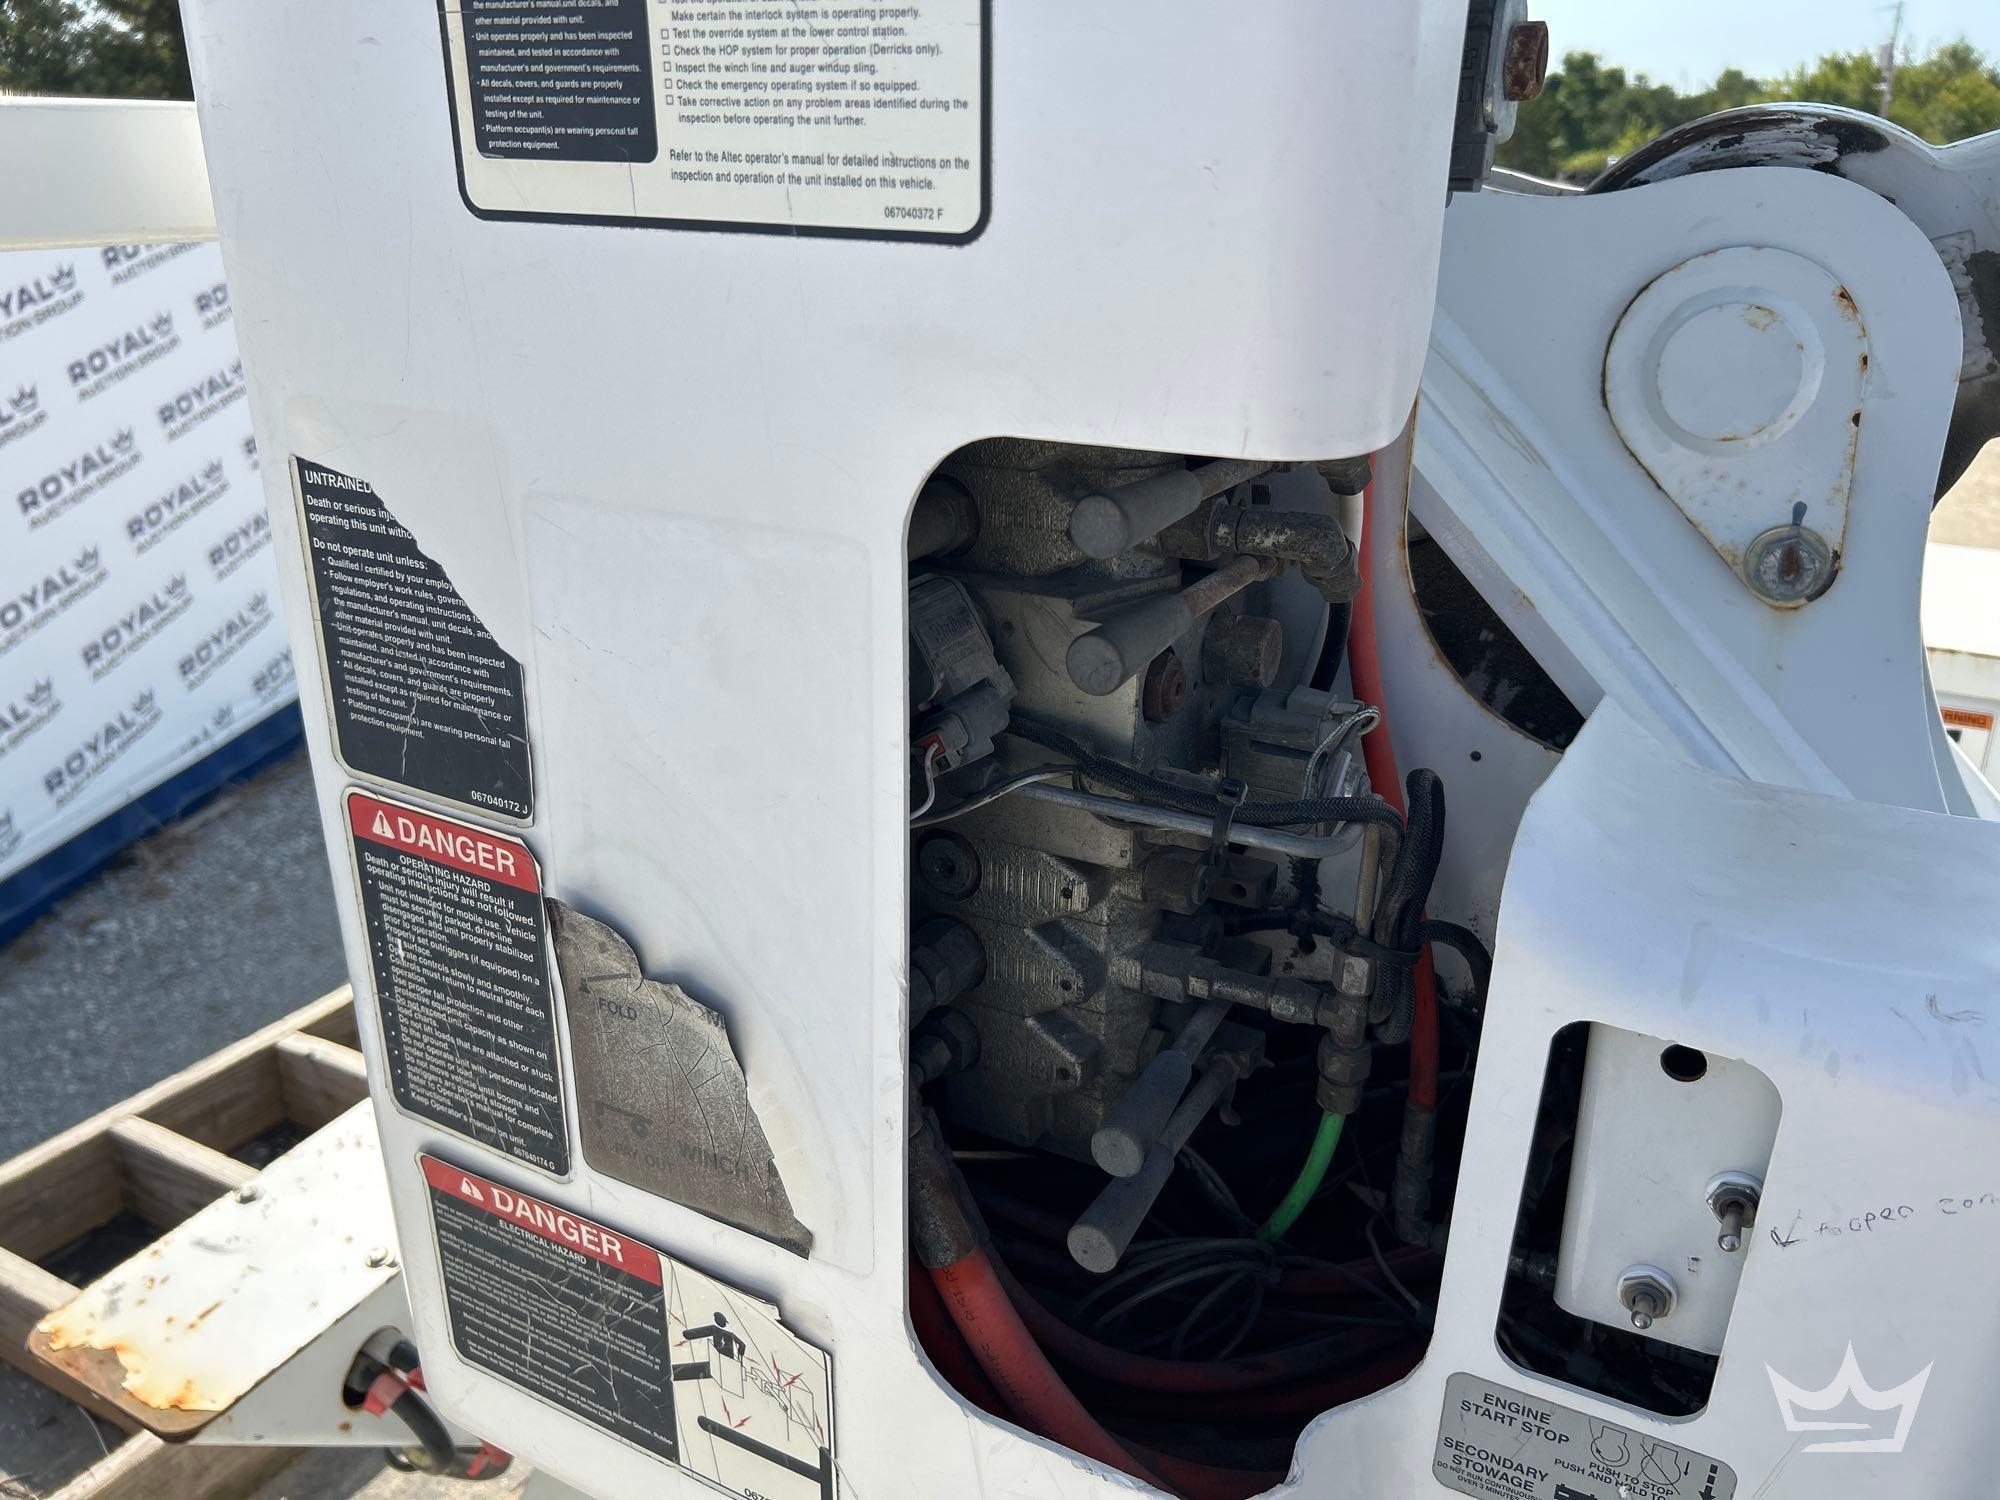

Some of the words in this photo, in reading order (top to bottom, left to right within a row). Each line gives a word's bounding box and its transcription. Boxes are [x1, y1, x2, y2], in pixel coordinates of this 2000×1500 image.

[673, 29, 690, 39] Test
[692, 29, 706, 39] the
[708, 28, 745, 39] override
[746, 28, 779, 41] system
[781, 28, 790, 38] at
[792, 28, 807, 38] the
[809, 27, 834, 37] lower
[837, 27, 869, 37] control
[872, 27, 907, 37] station.
[674, 46, 700, 56] Check
[702, 46, 716, 56] the
[719, 45, 739, 56] HOP
[741, 45, 773, 58] system
[775, 45, 788, 55] for
[790, 47, 820, 58] proper
[822, 45, 867, 57] operation
[869, 45, 913, 57] (Derricks
[915, 44, 943, 57] only).
[675, 62, 706, 75] Inspect
[708, 63, 722, 73] the
[724, 63, 749, 73] winch
[751, 63, 767, 73] line
[770, 63, 787, 73] and
[789, 65, 815, 76] auger
[817, 63, 850, 76] windup
[853, 64, 878, 76] sling.
[676, 80, 702, 90] Check
[704, 80, 718, 90] the
[721, 82, 768, 93] emergency
[771, 81, 813, 93] operating
[815, 81, 848, 93] system
[850, 81, 857, 91] if
[859, 83, 871, 91] so
[873, 81, 920, 94] equipped.
[485, 124, 513, 133] Platform
[514, 125, 553, 136] occupant(s)
[567, 126, 594, 136] wearing
[595, 126, 626, 136] personal
[627, 127, 639, 135] fall
[489, 140, 521, 150] protection
[522, 141, 560, 151] equipment.
[670, 150, 692, 161] Refer
[694, 151, 703, 162] to
[705, 151, 719, 162] the
[721, 152, 743, 163] Altec
[745, 153, 789, 166] operator's
[792, 155, 824, 165] manual
[827, 155, 839, 166] for
[842, 155, 879, 167] detailed
[881, 156, 936, 168] instructions
[939, 160, 951, 169] on
[954, 158, 969, 169] the
[671, 170, 713, 184] inspection
[716, 172, 732, 183] and
[734, 173, 775, 186] operation
[777, 174, 786, 184] of
[788, 174, 802, 185] the
[804, 175, 822, 186] unit
[824, 175, 862, 187] installed
[865, 179, 877, 187] on
[879, 177, 896, 188] this
[899, 178, 936, 189] vehicle.
[885, 207, 934, 219] 067040372
[938, 208, 943, 219] F
[67, 325, 153, 386] ROYAL
[158, 368, 234, 425] ROYAL
[17, 446, 115, 515] ROYAL
[305, 470, 372, 494] UNTRAINED
[126, 475, 206, 539] ROYAL
[306, 494, 332, 509] Death
[333, 502, 342, 511] or
[344, 504, 376, 517] serious
[209, 511, 269, 565] ROYA
[309, 513, 349, 530] operating
[350, 518, 367, 531] this
[369, 523, 387, 534] unit
[388, 526, 415, 539] witho
[313, 538, 325, 550] Do
[327, 542, 341, 553] not
[343, 546, 375, 559] operate
[376, 552, 393, 563] unit
[395, 556, 428, 570] unless:
[328, 556, 360, 571] Qualified
[365, 565, 394, 578] certified
[395, 570, 405, 582] by
[406, 574, 424, 584] your
[82, 593, 168, 665] ROYAL
[335, 609, 353, 621] other
[355, 615, 383, 628] material
[384, 622, 417, 636] provided
[418, 628, 434, 640] with
[435, 633, 452, 644] unit.
[178, 611, 251, 677] ROYAL
[44, 712, 136, 794] ROYAL
[471, 790, 520, 812] 067040172
[522, 804, 528, 814] J
[398, 816, 516, 876] DANGER
[365, 852, 389, 867] Death
[390, 862, 400, 871] or
[401, 866, 433, 882] serious
[435, 875, 460, 893] injury
[462, 885, 478, 897] will
[480, 891, 505, 906] result
[507, 899, 515, 910] if
[399, 854, 450, 879] OPERATING
[452, 872, 491, 892] HAZARD
[367, 864, 406, 886] operating
[407, 877, 459, 902] instructions
[461, 897, 475, 907] are
[477, 902, 492, 912] not
[494, 906, 536, 927] followed.
[491, 1187, 623, 1263] DANGER
[499, 1219, 549, 1249] ELECTRICAL
[551, 1243, 587, 1265] HAZARD
[1461, 1400, 1518, 1427] START
[1521, 1421, 1570, 1445] STOP
[1483, 1392, 1551, 1424] ENGINE
[1437, 1460, 1448, 1469] DO
[1450, 1465, 1465, 1476] NOT
[1467, 1472, 1483, 1482] RUN
[1443, 1437, 1549, 1482] SECONDARY
[1452, 1454, 1535, 1492] STOWAGE
[1554, 1458, 1585, 1475] PUSH
[1588, 1471, 1612, 1484] AND
[1457, 1475, 1478, 1487] OVER
[1589, 1461, 1621, 1478] PUSH
[1624, 1473, 1640, 1485] TO
[1642, 1481, 1674, 1497] STOP
